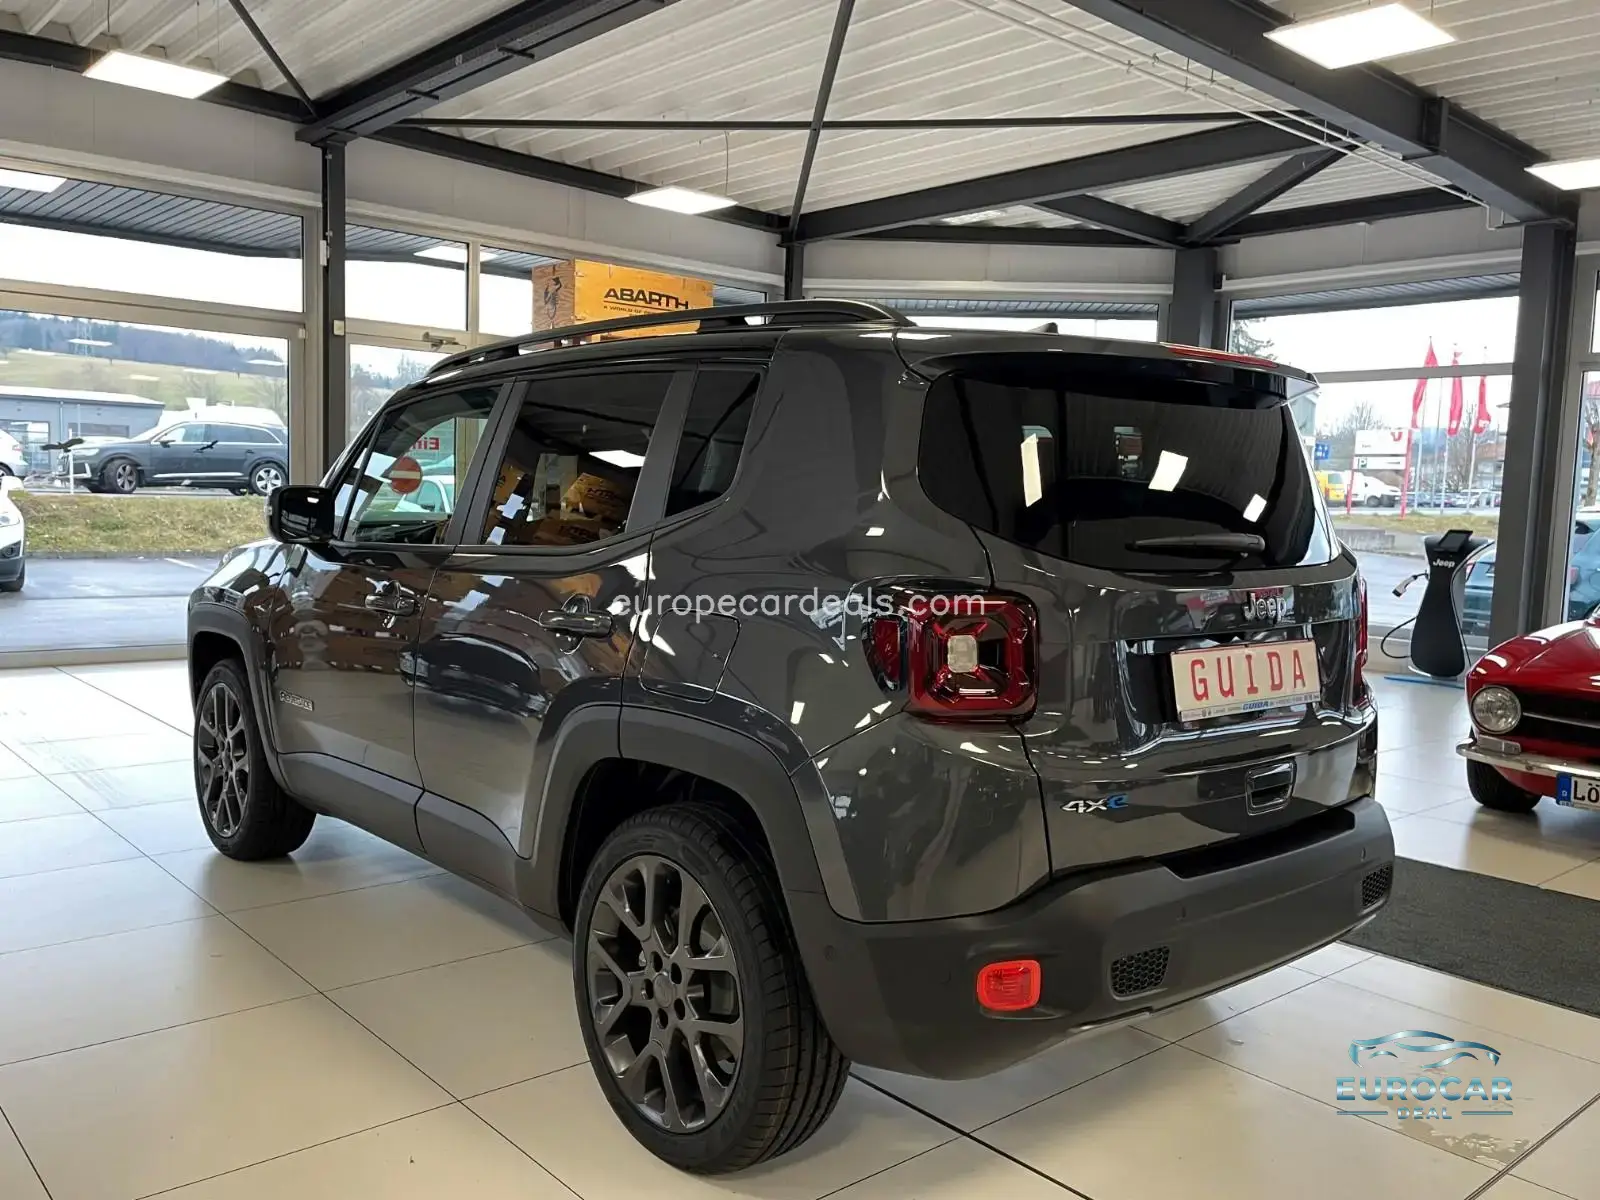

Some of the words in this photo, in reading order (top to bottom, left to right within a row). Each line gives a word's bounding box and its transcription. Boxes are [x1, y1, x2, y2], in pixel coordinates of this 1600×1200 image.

[604, 288, 688, 309] ABARTH
[1433, 558, 1456, 569] Jeep
[1243, 592, 1287, 622] Jeep
[1190, 649, 1307, 702] GUIDA
[1242, 701, 1270, 711] GUIDA
[1573, 780, 1600, 803] LÖ
